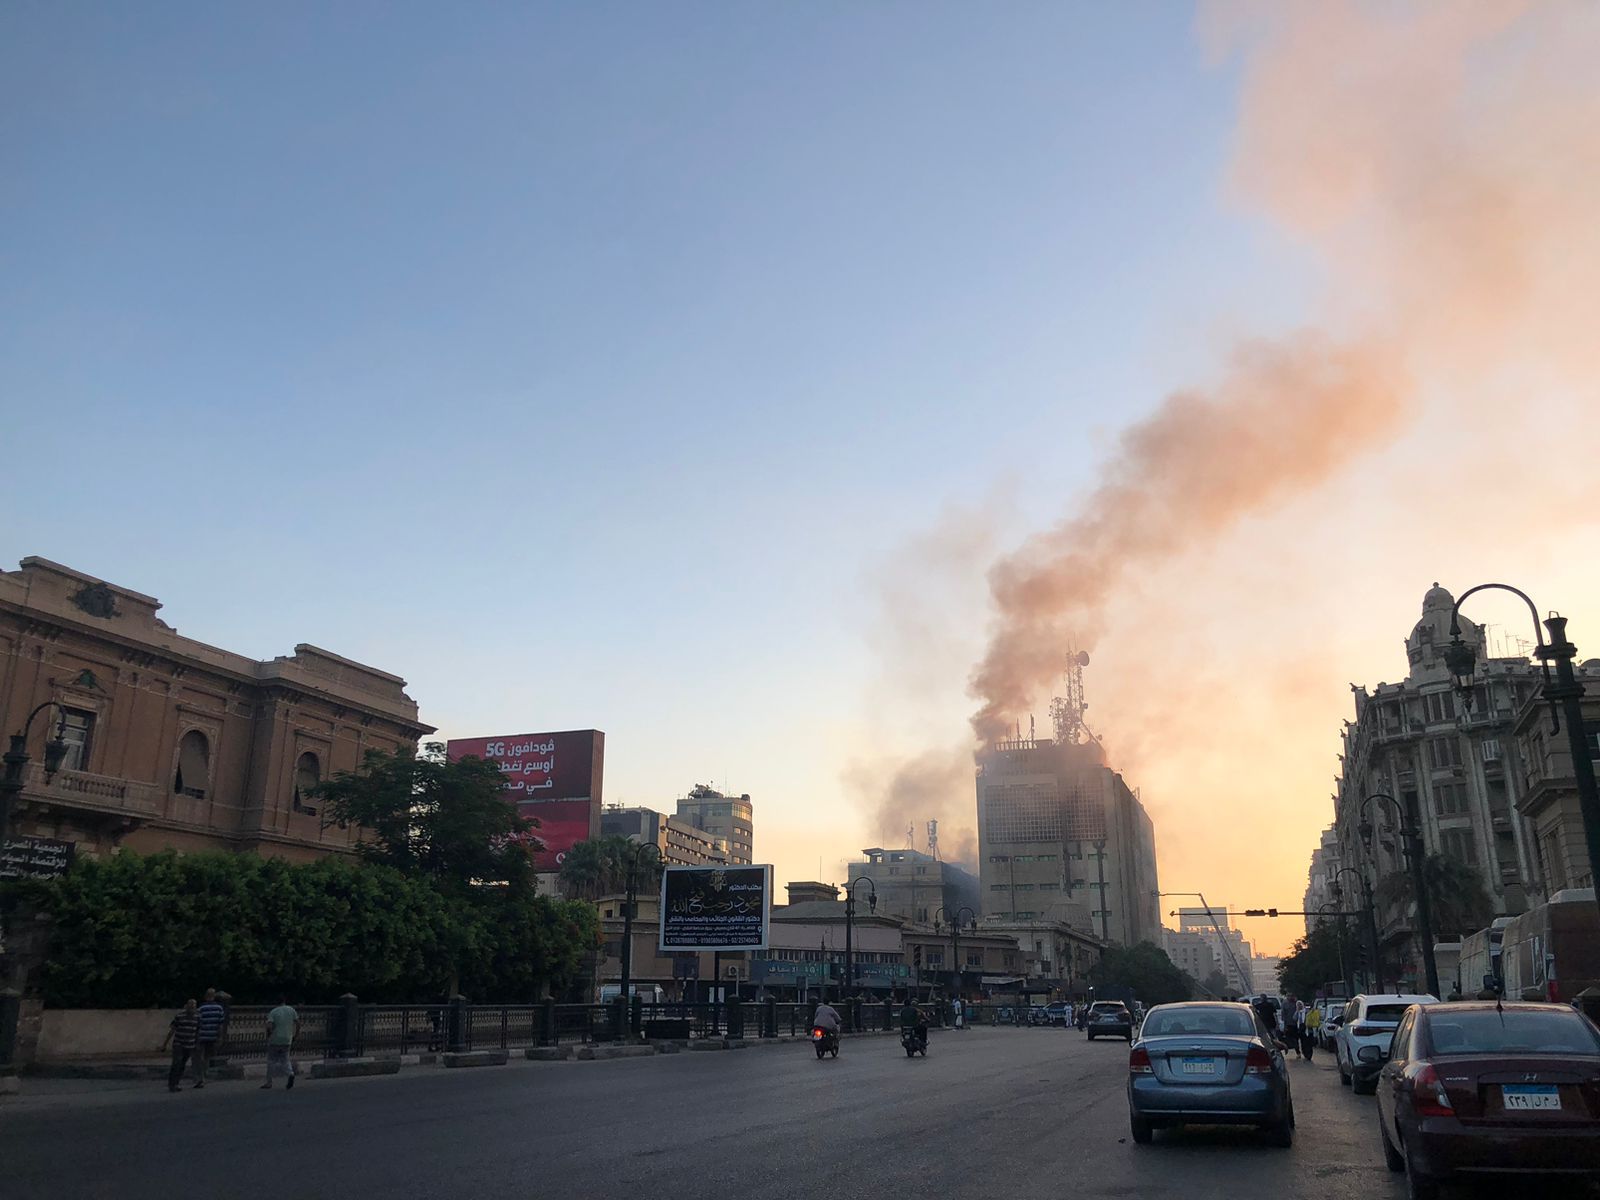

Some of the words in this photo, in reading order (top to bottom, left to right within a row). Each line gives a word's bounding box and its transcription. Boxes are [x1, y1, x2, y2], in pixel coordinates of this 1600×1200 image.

[485, 742, 505, 757] 5G
[523, 755, 554, 775] أوسع
[34, 840, 67, 855] الجمعية
